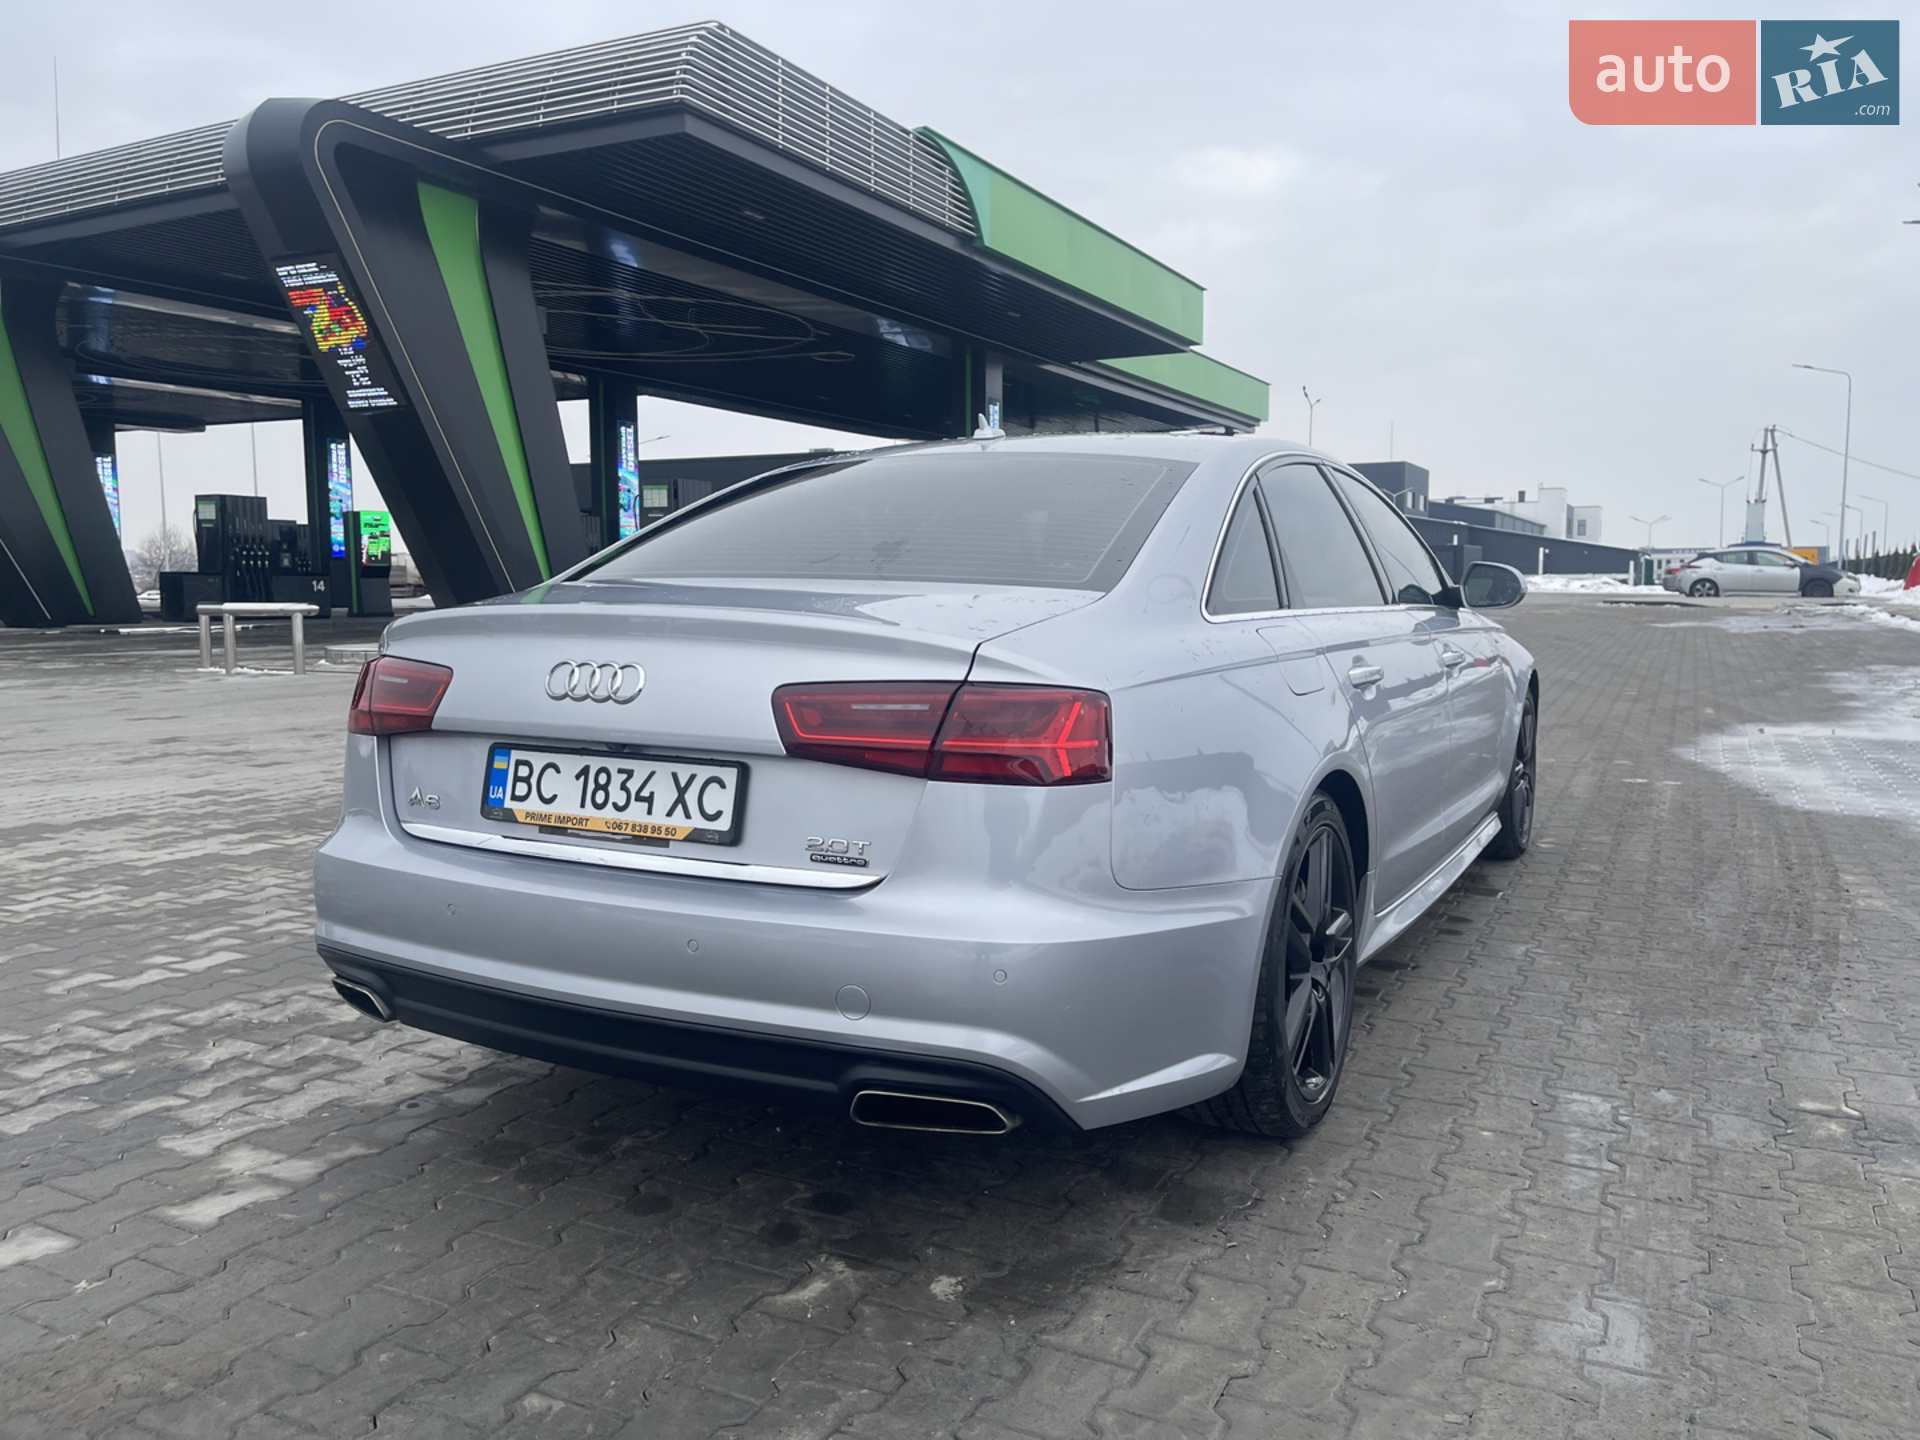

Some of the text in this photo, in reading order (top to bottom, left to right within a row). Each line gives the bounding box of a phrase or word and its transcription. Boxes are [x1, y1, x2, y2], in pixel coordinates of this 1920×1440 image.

[337, 442, 347, 484] DIESEL
[312, 580, 325, 592] 14
[409, 786, 441, 810] A6
[489, 785, 504, 800] UA
[510, 758, 727, 822] BC 1834 XC
[524, 811, 678, 837] PRIME IMPORT 067 838 95 50
[811, 853, 867, 867] quattro
